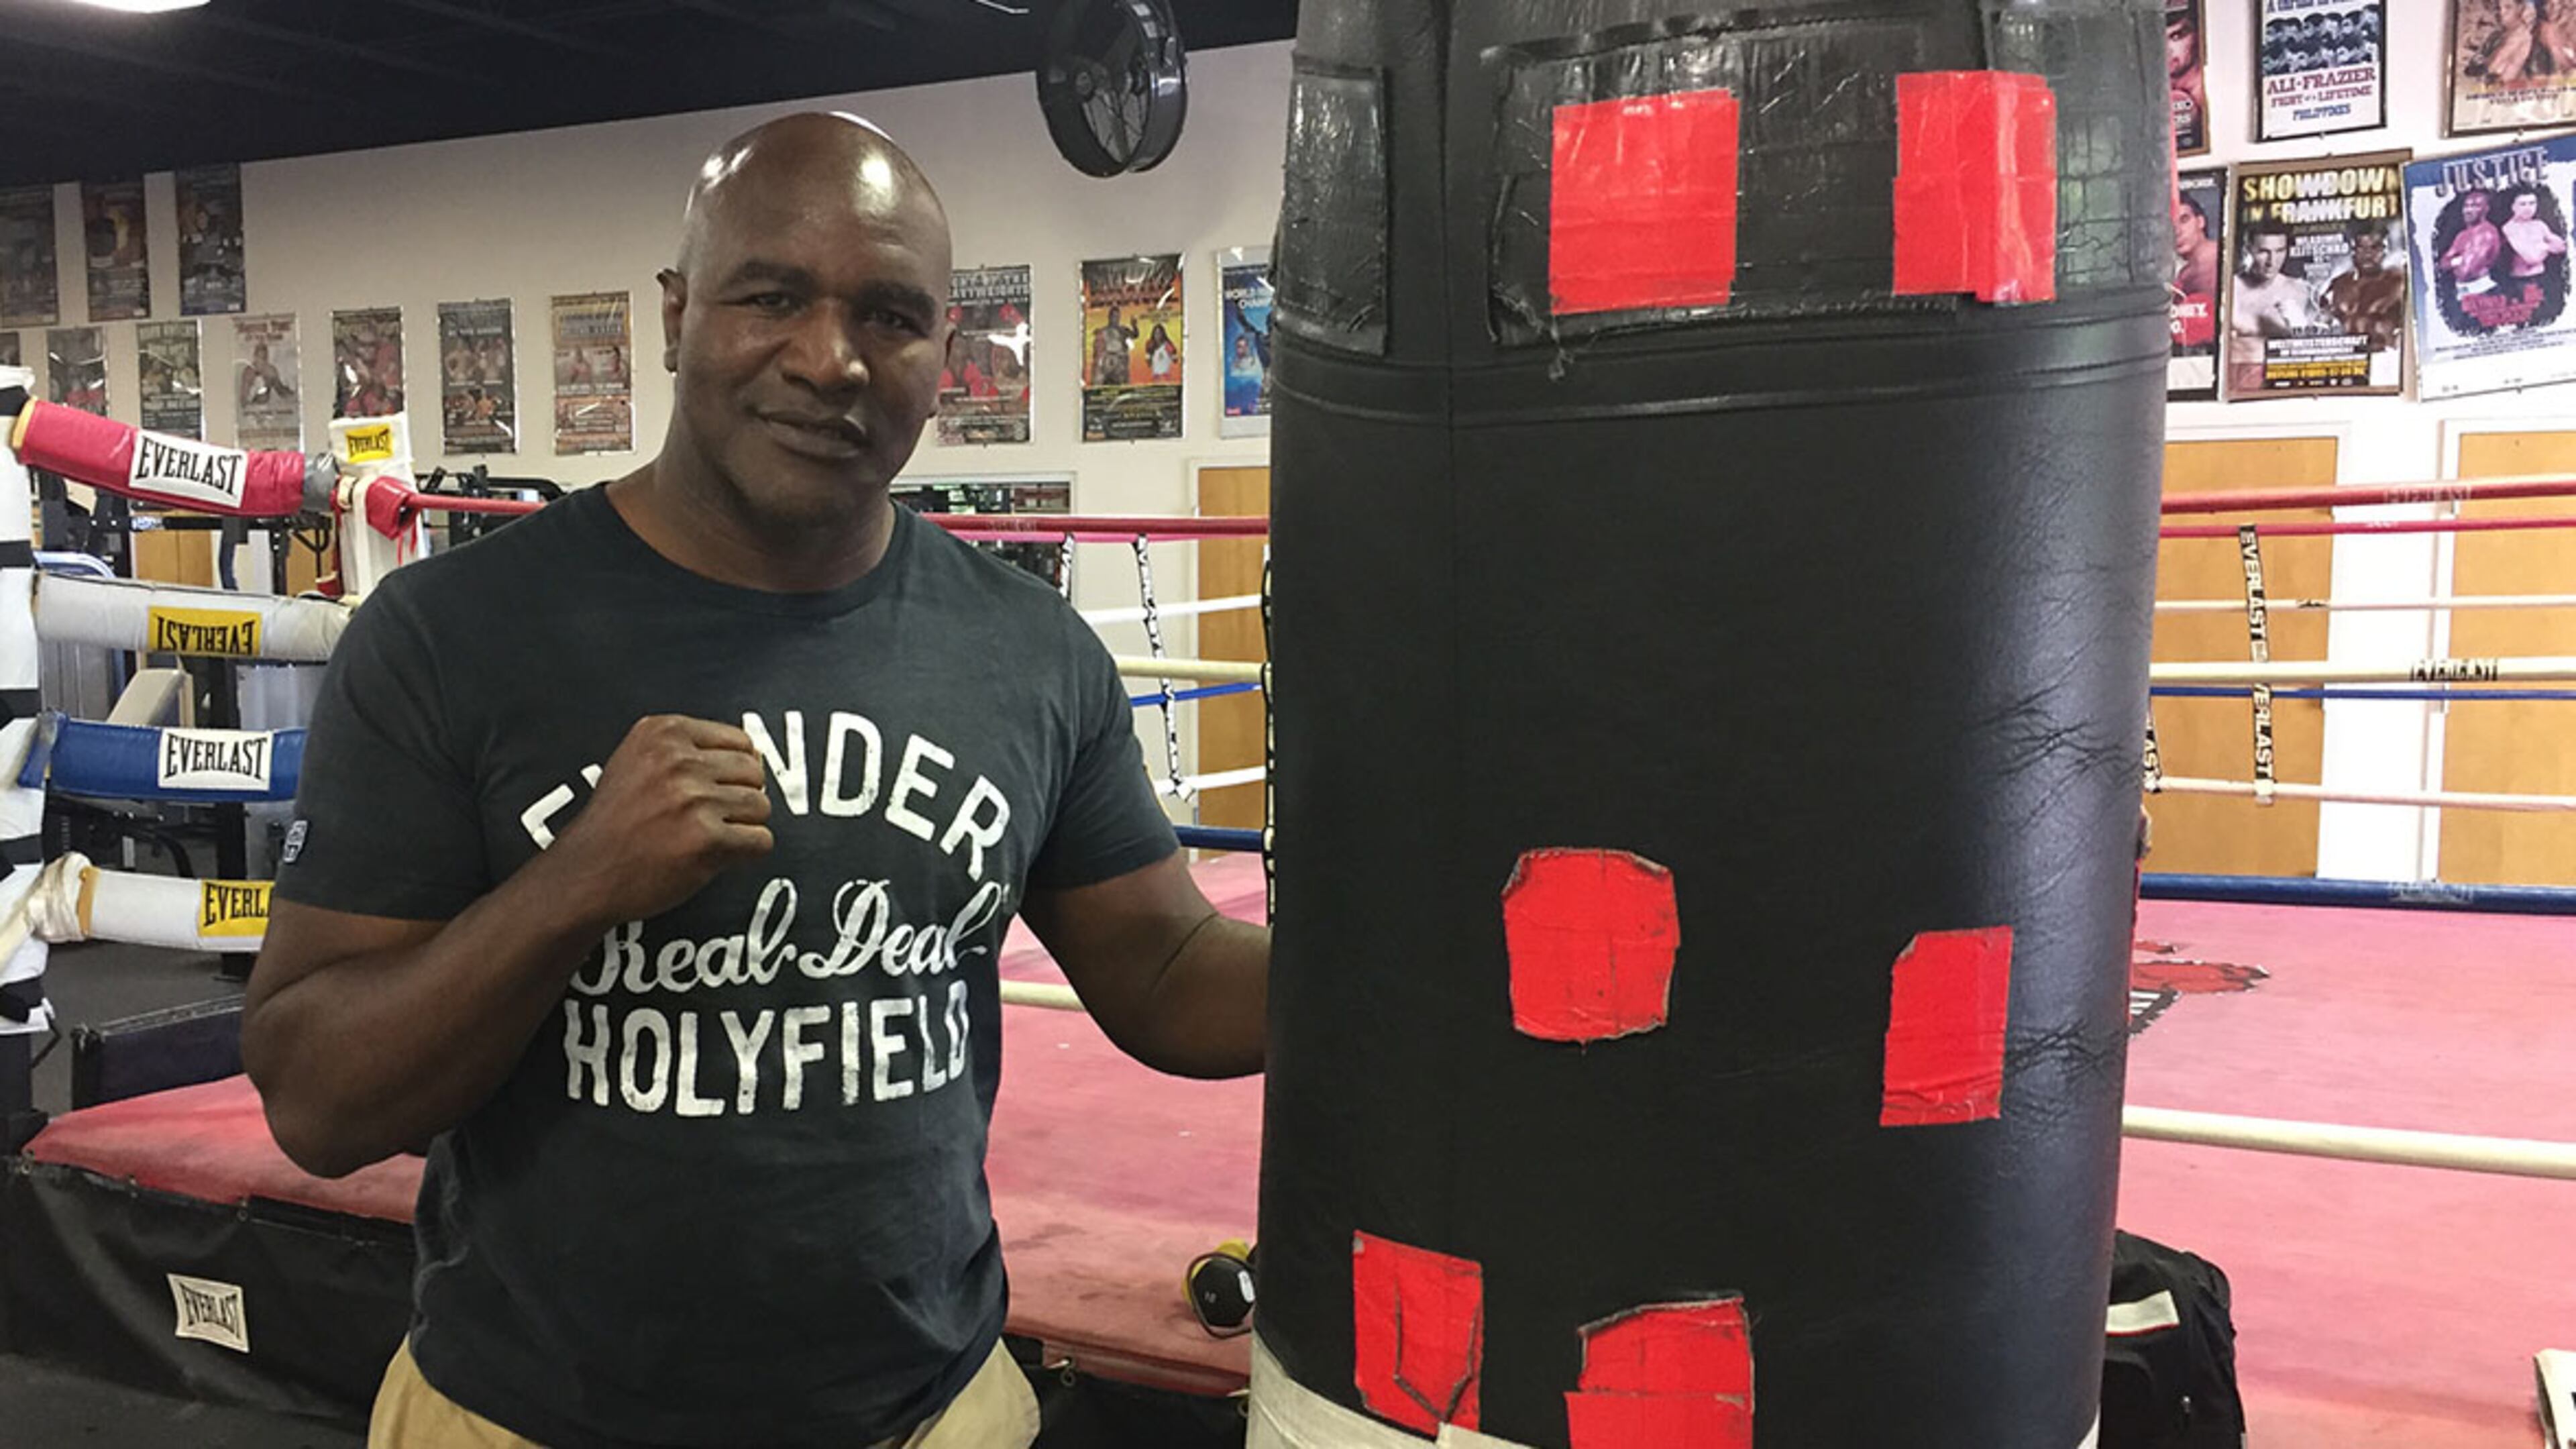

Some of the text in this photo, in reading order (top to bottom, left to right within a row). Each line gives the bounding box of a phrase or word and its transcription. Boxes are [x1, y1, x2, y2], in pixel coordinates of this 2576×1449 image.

[2243, 168, 2399, 201] SHOWDOWN
[2435, 146, 2549, 197] JUSTICE
[2270, 195, 2398, 225] FRANKFURT
[135, 435, 242, 496] EVERLAST
[347, 428, 390, 458] EVERLAST
[2241, 530, 2267, 641] EVERLAST
[156, 614, 255, 656] EVERLAST
[164, 733, 268, 780] EVERLAST
[521, 710, 1011, 882] NDER
[203, 882, 270, 926] EVERL
[569, 879, 797, 996] Real
[564, 979, 970, 1117] HOLYFIELD
[178, 1282, 240, 1340] EVERLAST
